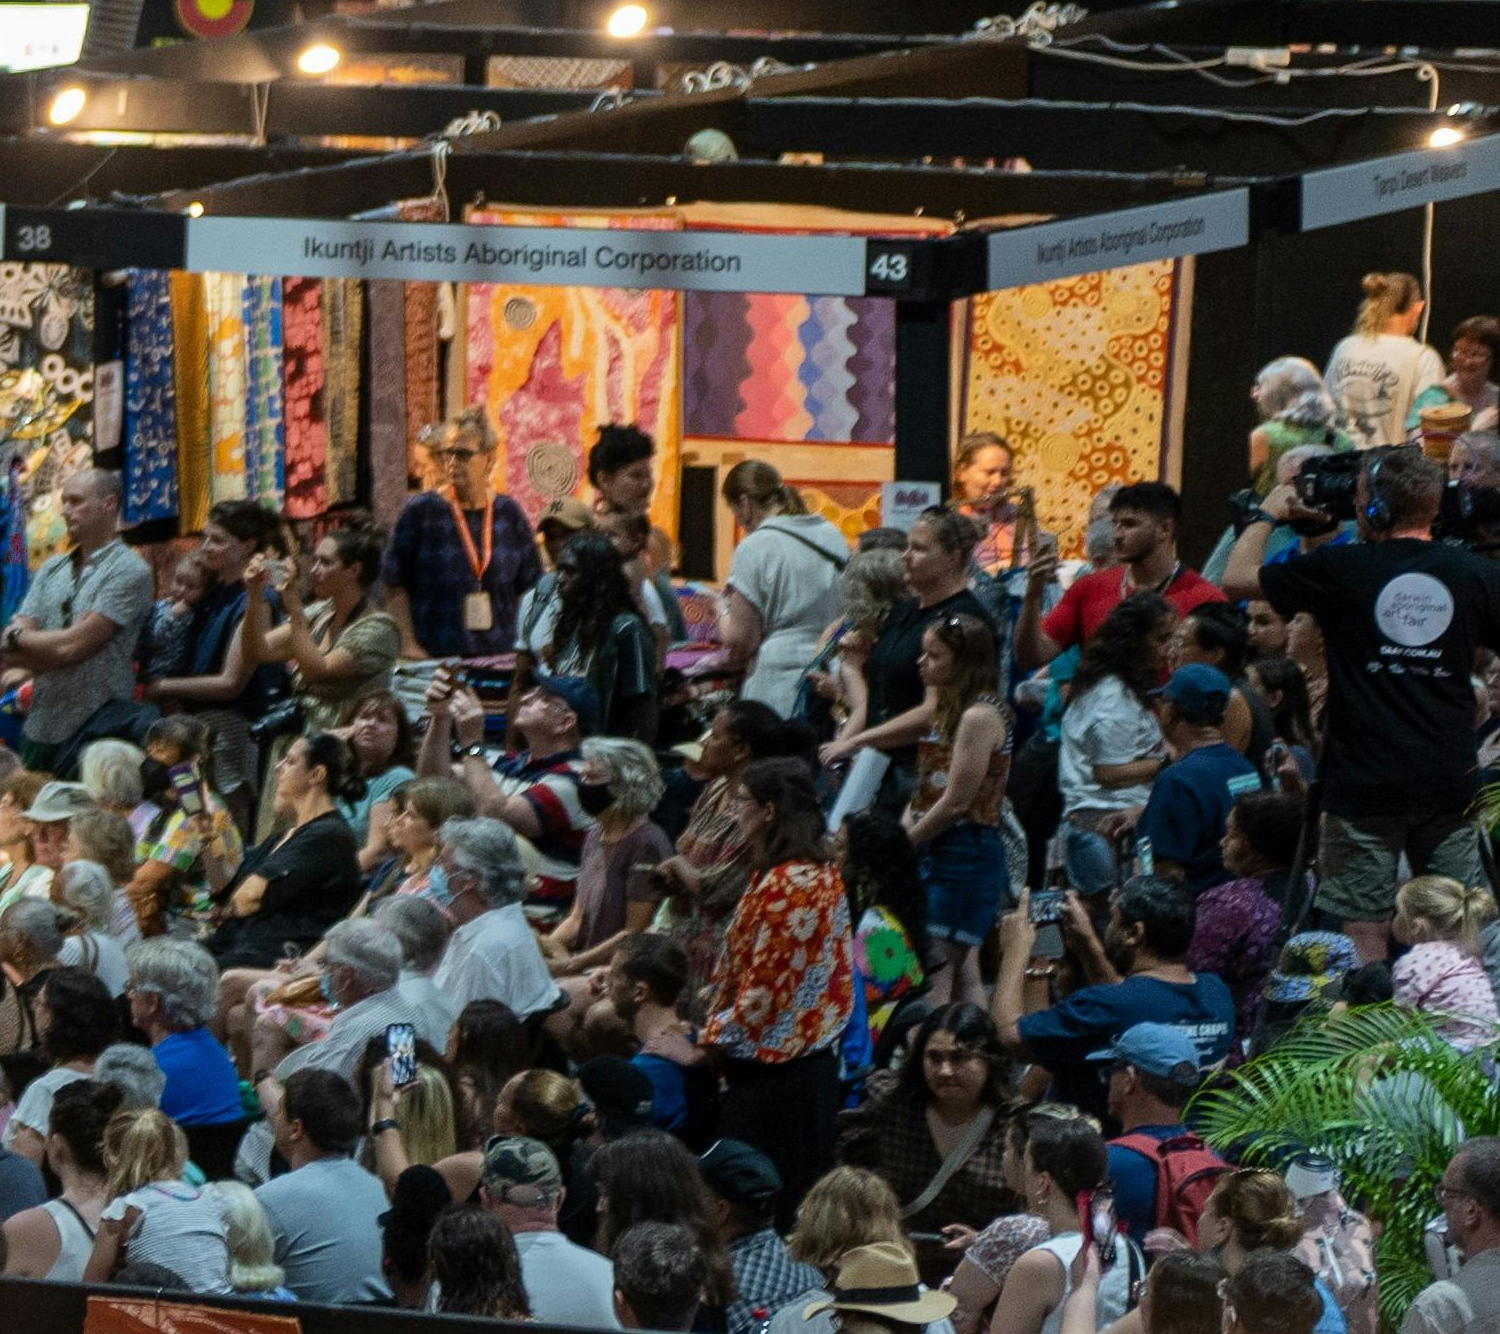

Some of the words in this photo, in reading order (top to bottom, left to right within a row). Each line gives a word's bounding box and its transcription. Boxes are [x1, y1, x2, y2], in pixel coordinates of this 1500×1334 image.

[17, 224, 52, 251] 38
[304, 237, 375, 268] Ikuntji
[380, 239, 457, 265] Artists
[463, 242, 587, 271] Aboriginal
[595, 246, 742, 277] Corporation
[870, 253, 908, 280] 43
